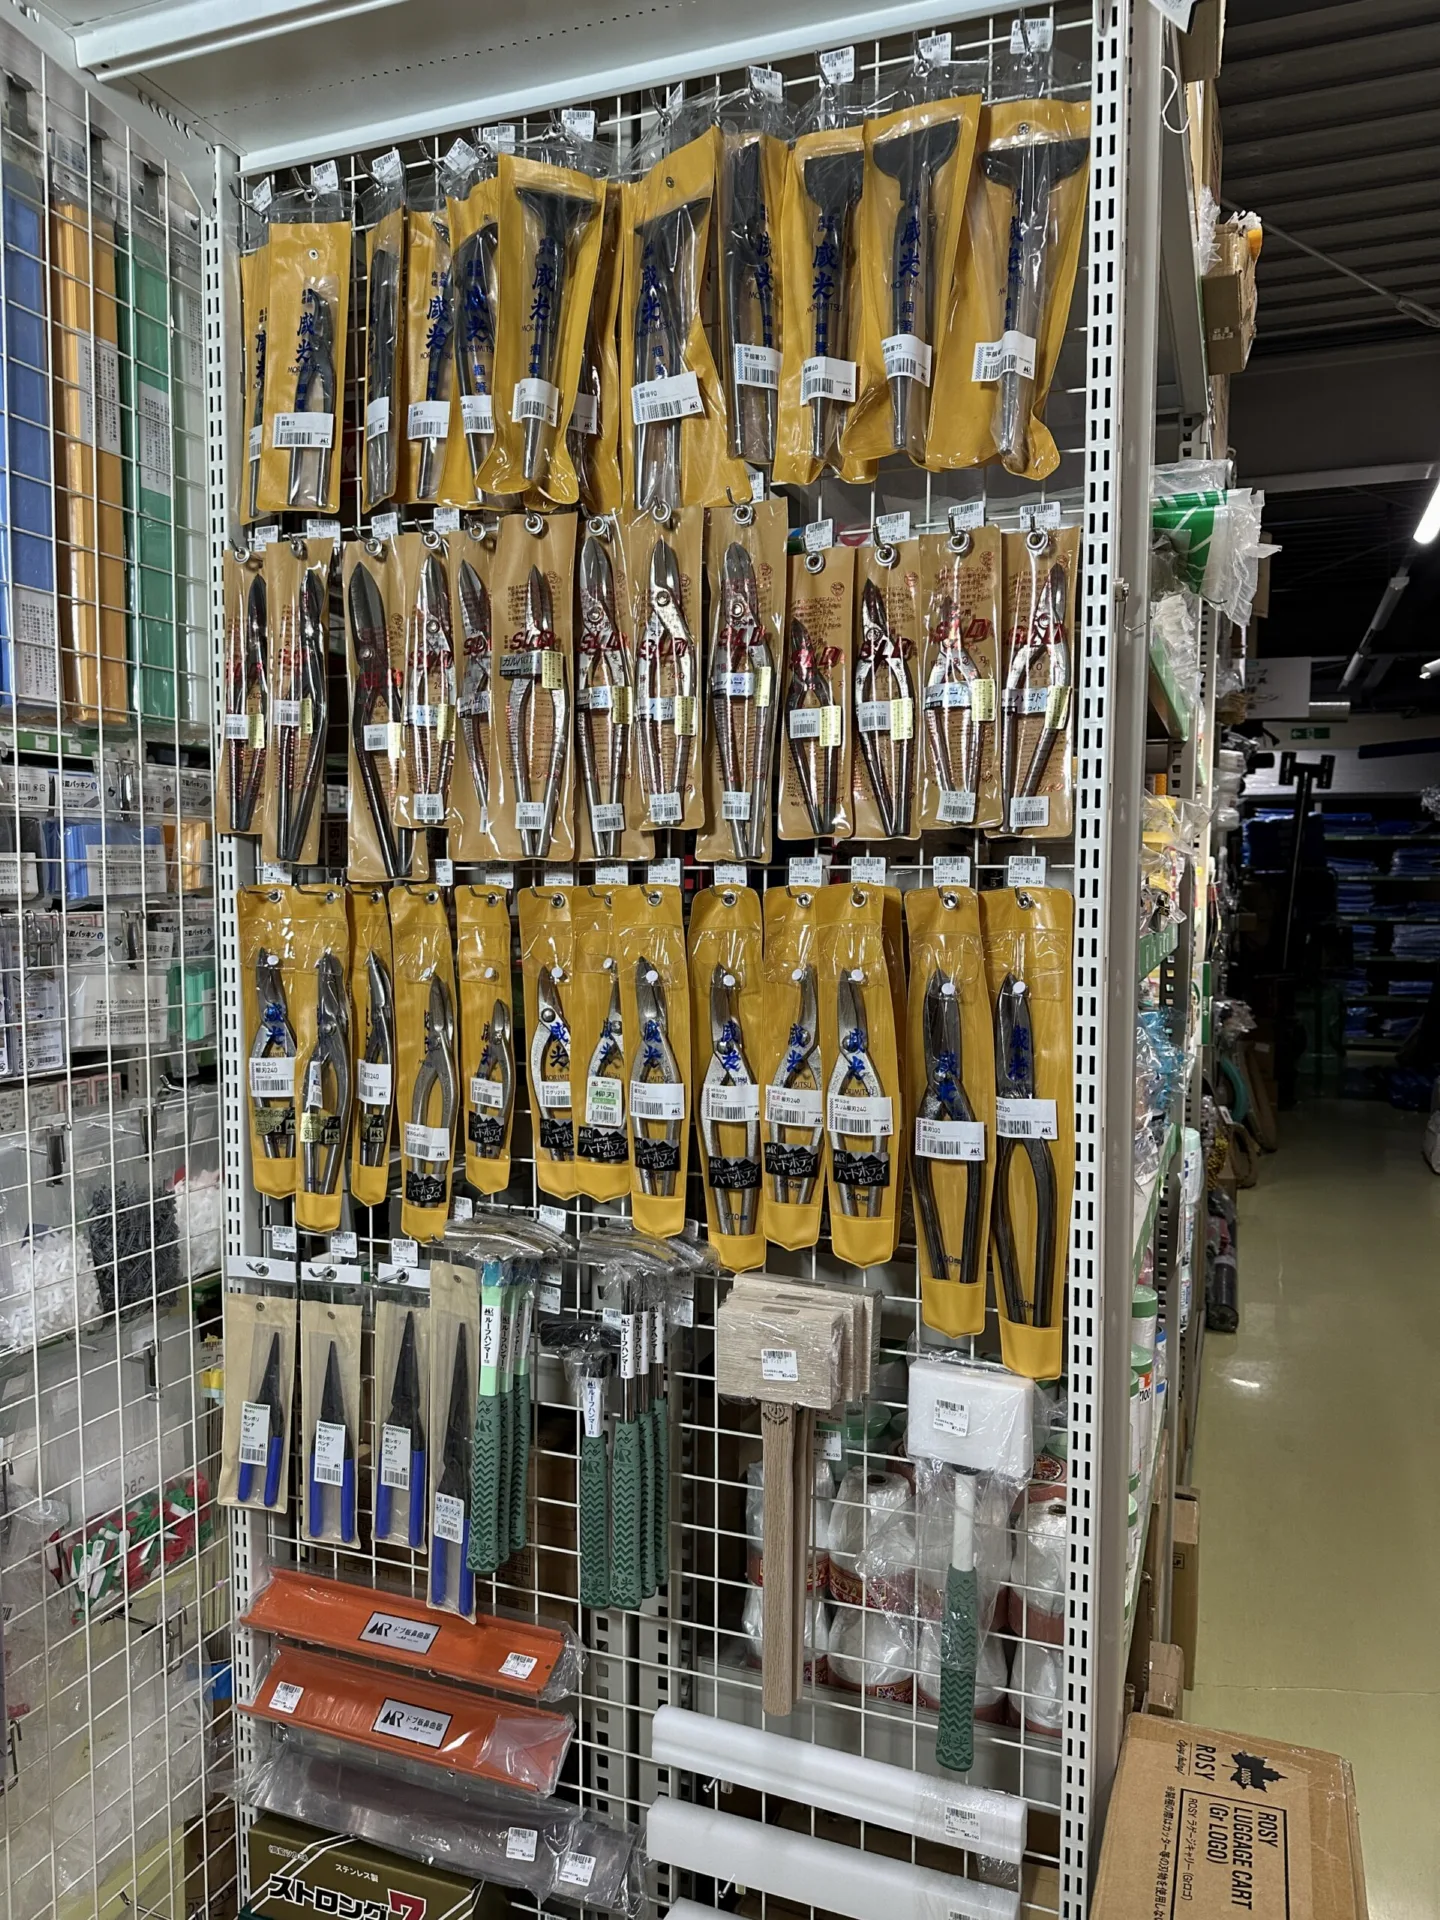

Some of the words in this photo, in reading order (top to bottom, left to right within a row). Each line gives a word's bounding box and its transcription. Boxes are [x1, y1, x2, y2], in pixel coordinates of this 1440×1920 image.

[368, 1621, 393, 1637] MR
[381, 1709, 405, 1728] MR
[1194, 1743, 1217, 1782] ROSY
[1188, 1797, 1198, 1818] ROSY
[1209, 1802, 1231, 1822] (Gr
[1206, 1823, 1230, 1865] LOGO)
[1233, 1807, 1253, 1869] LUGGAGE
[1258, 1811, 1279, 1848] ROSY
[335, 1863, 379, 1883] ステンレス製
[1231, 1869, 1253, 1911] CART
